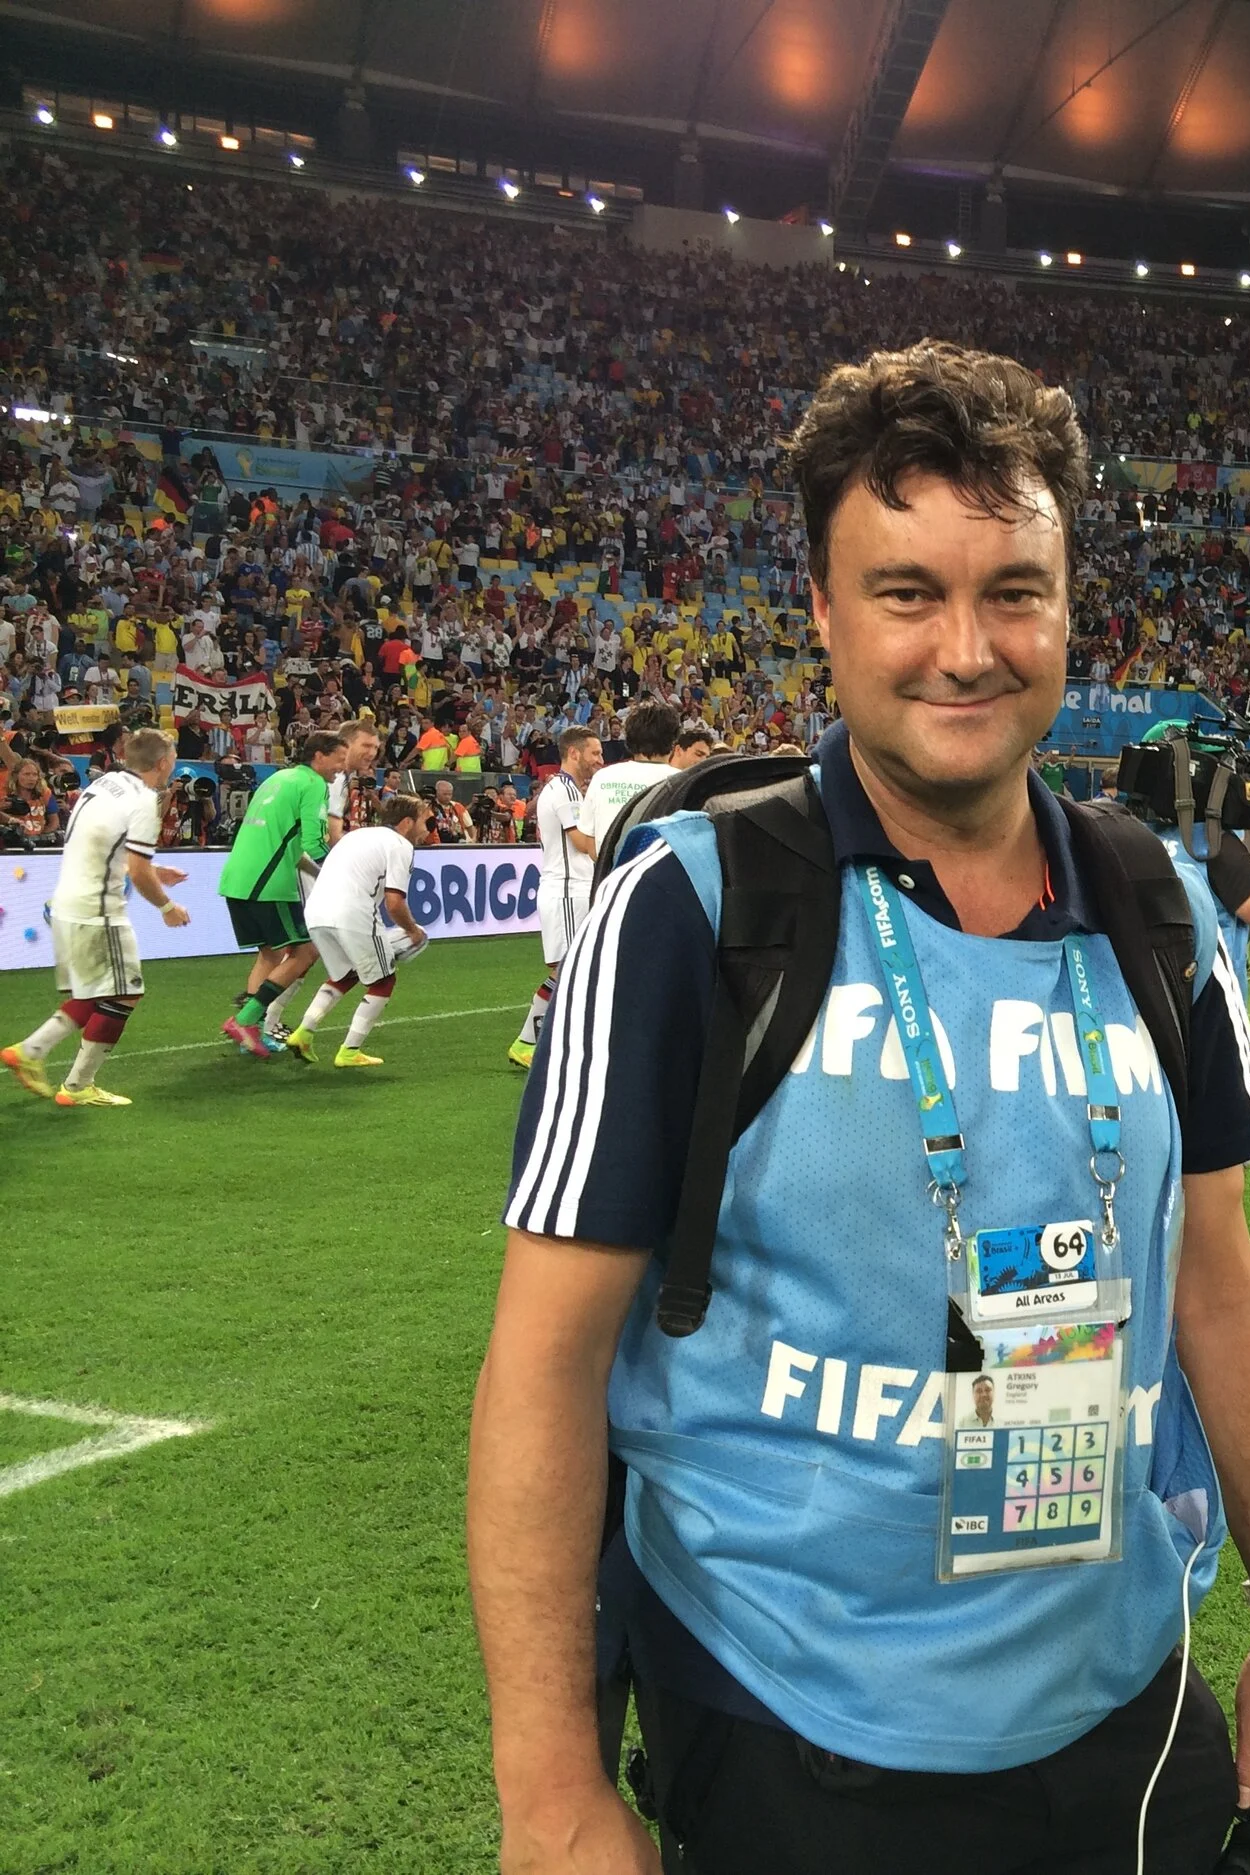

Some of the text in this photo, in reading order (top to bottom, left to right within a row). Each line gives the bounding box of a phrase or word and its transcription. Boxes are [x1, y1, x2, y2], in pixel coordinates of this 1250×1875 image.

[1072, 949, 1093, 1009] SONY
[893, 973, 920, 1039] SONY
[1053, 1231, 1085, 1258] 64
[1015, 1292, 1066, 1308] All Areas
[1006, 1383, 1039, 1391] Gregory
[1007, 1373, 1037, 1381] ATKINS
[964, 1436, 987, 1444] FIFA1
[1018, 1432, 1096, 1454] 1 2 3
[1016, 1464, 1095, 1488] 4 5 6
[1015, 1499, 1092, 1523] 7 8 9
[966, 1520, 986, 1530] IBC
